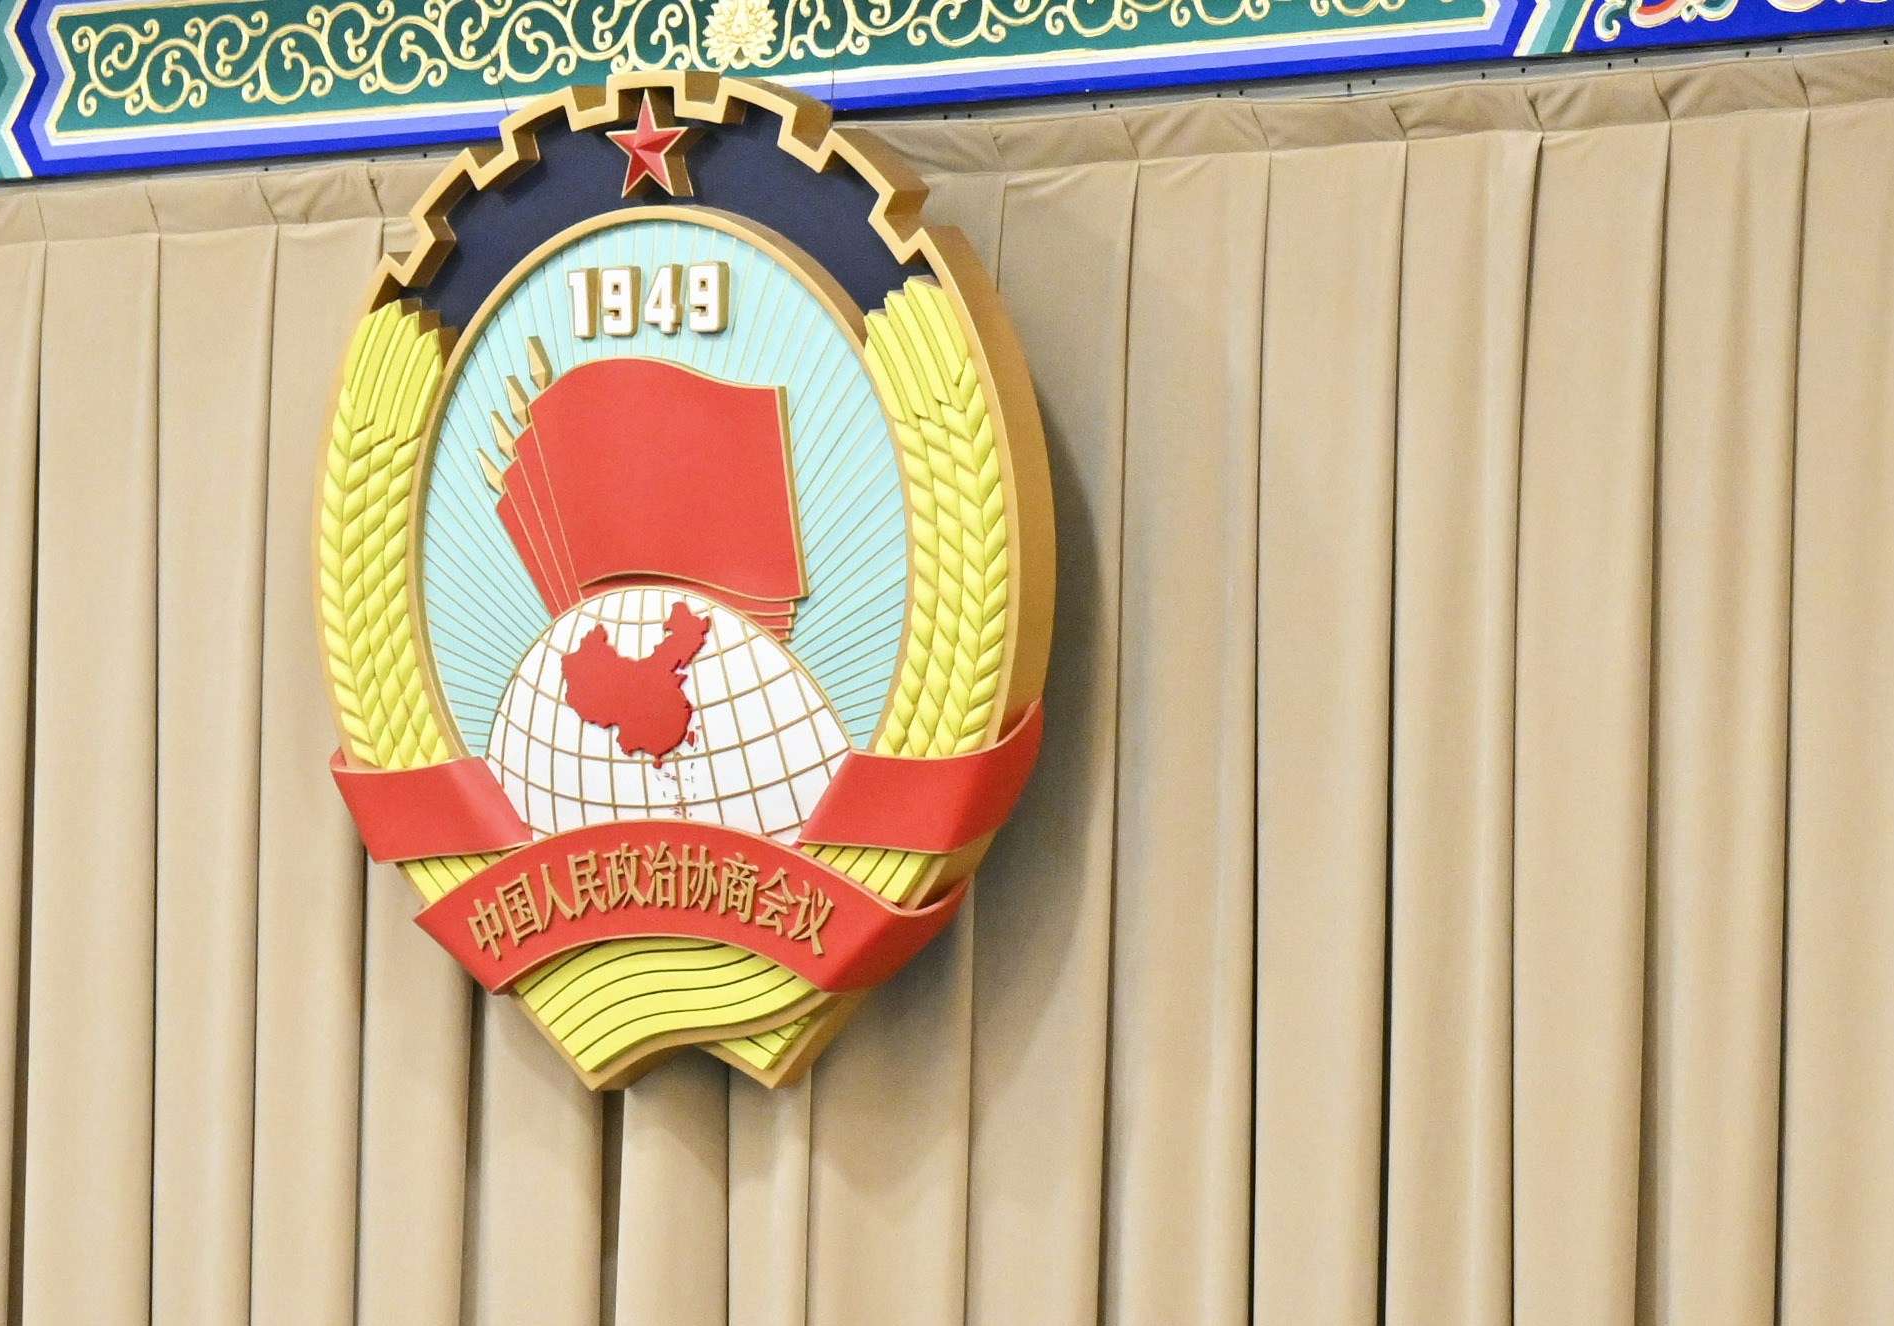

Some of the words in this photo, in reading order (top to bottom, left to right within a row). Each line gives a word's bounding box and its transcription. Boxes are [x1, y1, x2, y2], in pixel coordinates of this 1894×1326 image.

[568, 261, 730, 340] 1949
[467, 841, 834, 960] 中国人民政治协商会议
